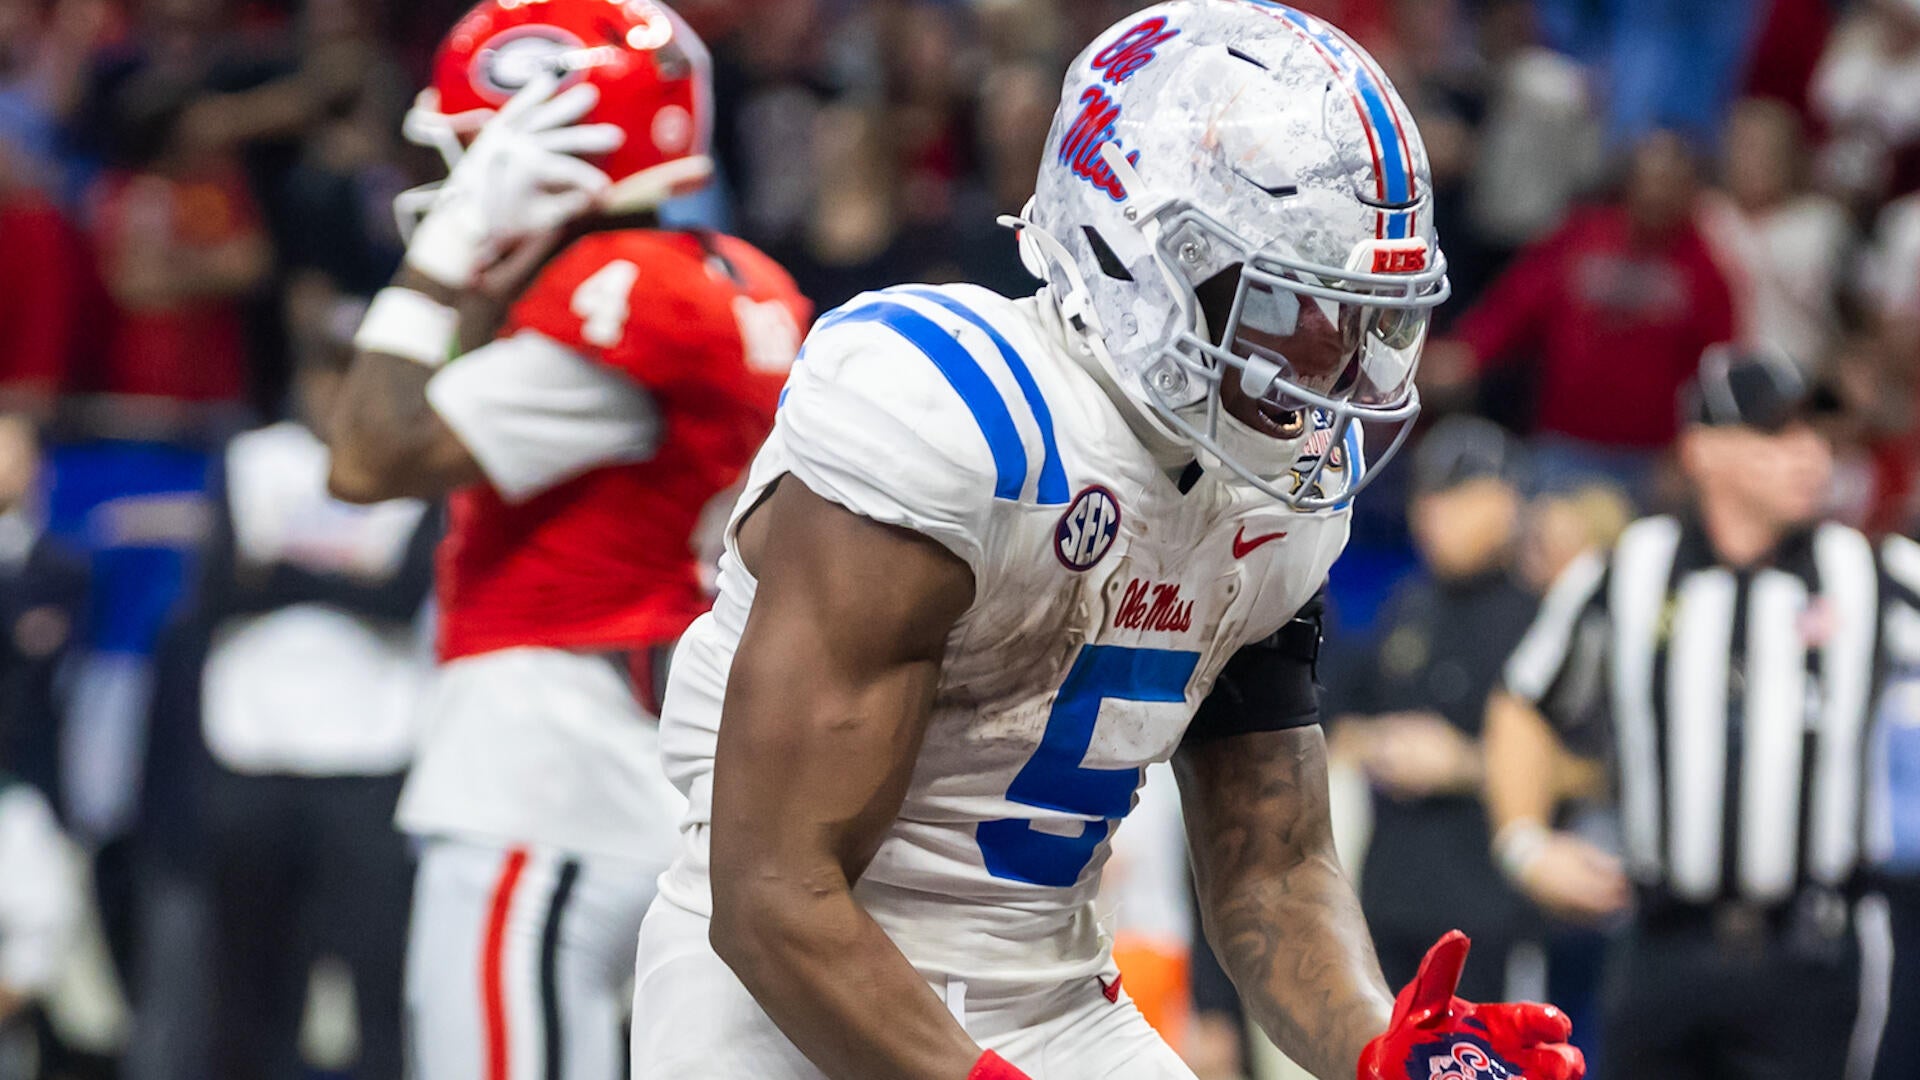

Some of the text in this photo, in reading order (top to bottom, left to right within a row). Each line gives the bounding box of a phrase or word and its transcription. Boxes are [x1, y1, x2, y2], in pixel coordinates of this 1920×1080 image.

[1090, 16, 1181, 86] Ole
[569, 258, 640, 348] 4
[1060, 491, 1117, 566] SEC
[1114, 578, 1196, 633] Ole Miss
[976, 643, 1201, 887] 5
